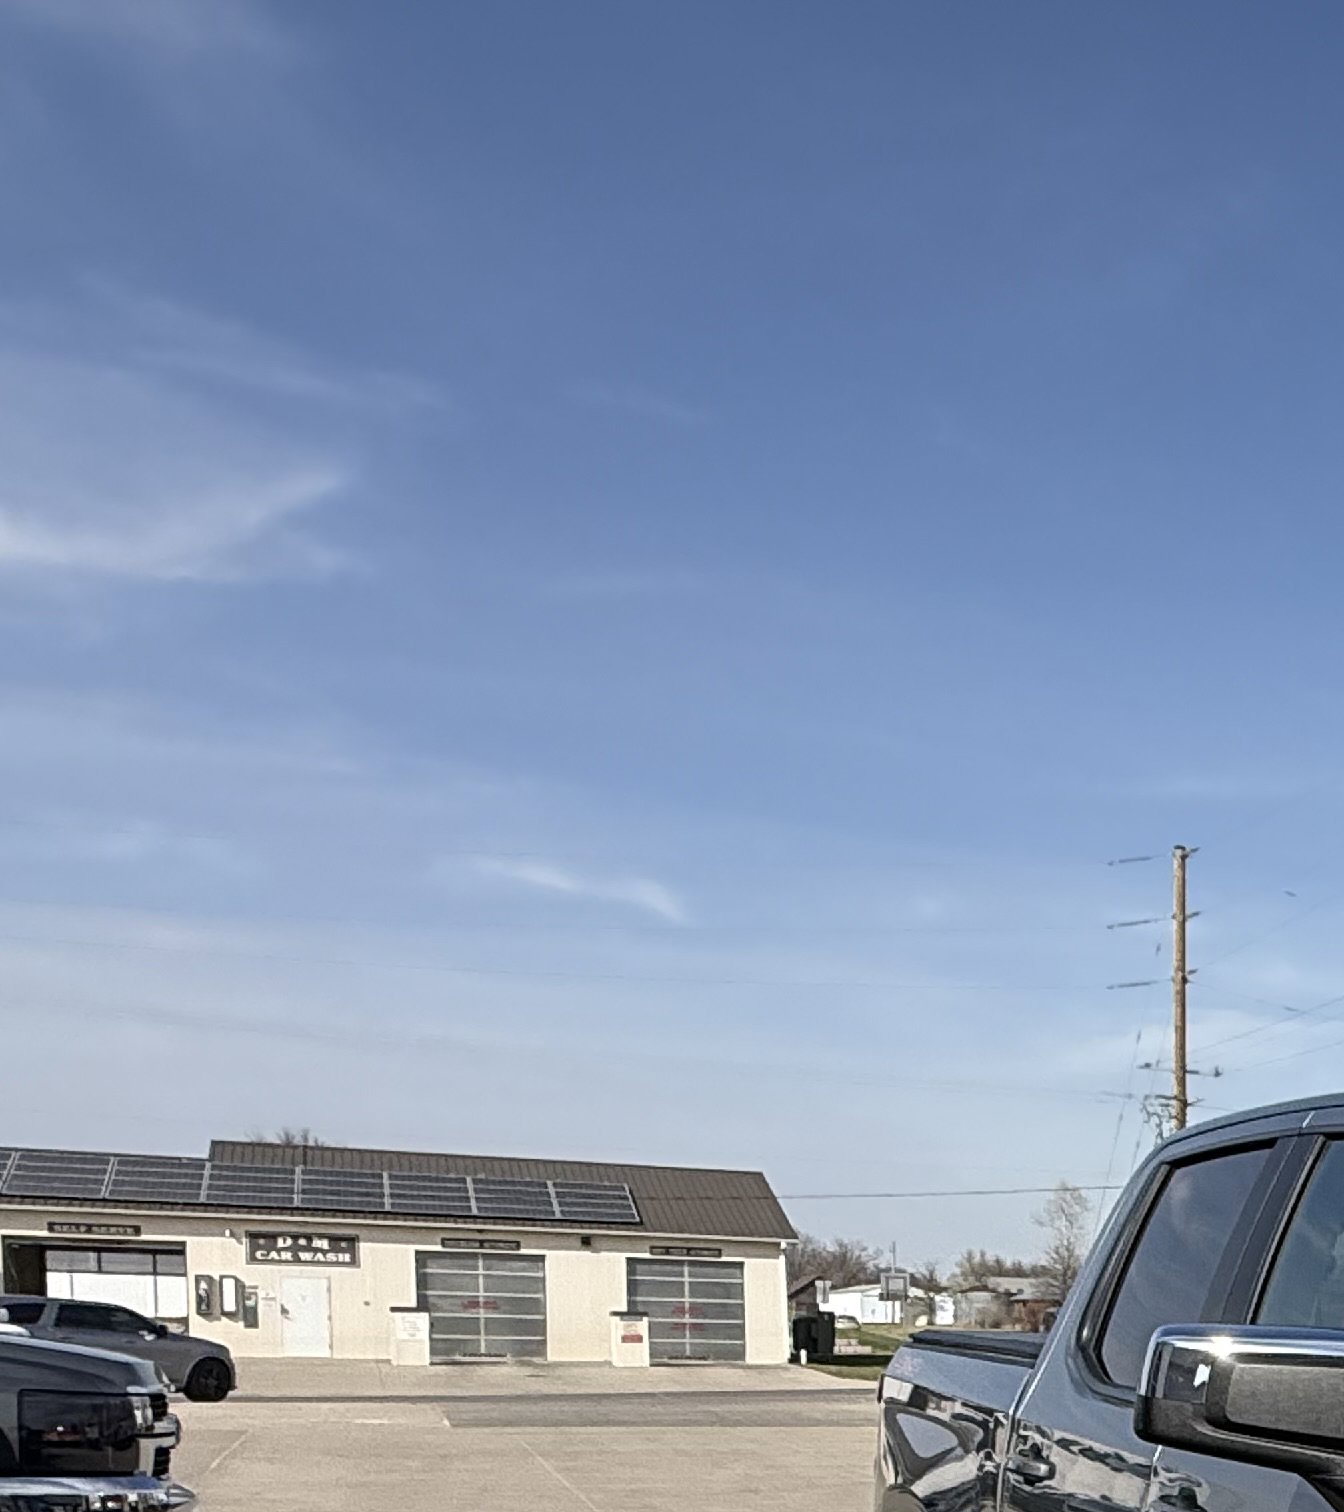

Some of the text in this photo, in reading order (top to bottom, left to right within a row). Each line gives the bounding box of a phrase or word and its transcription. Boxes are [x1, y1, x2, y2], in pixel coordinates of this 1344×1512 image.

[276, 1236, 293, 1248] D
[254, 1250, 352, 1262] CAR WASH
